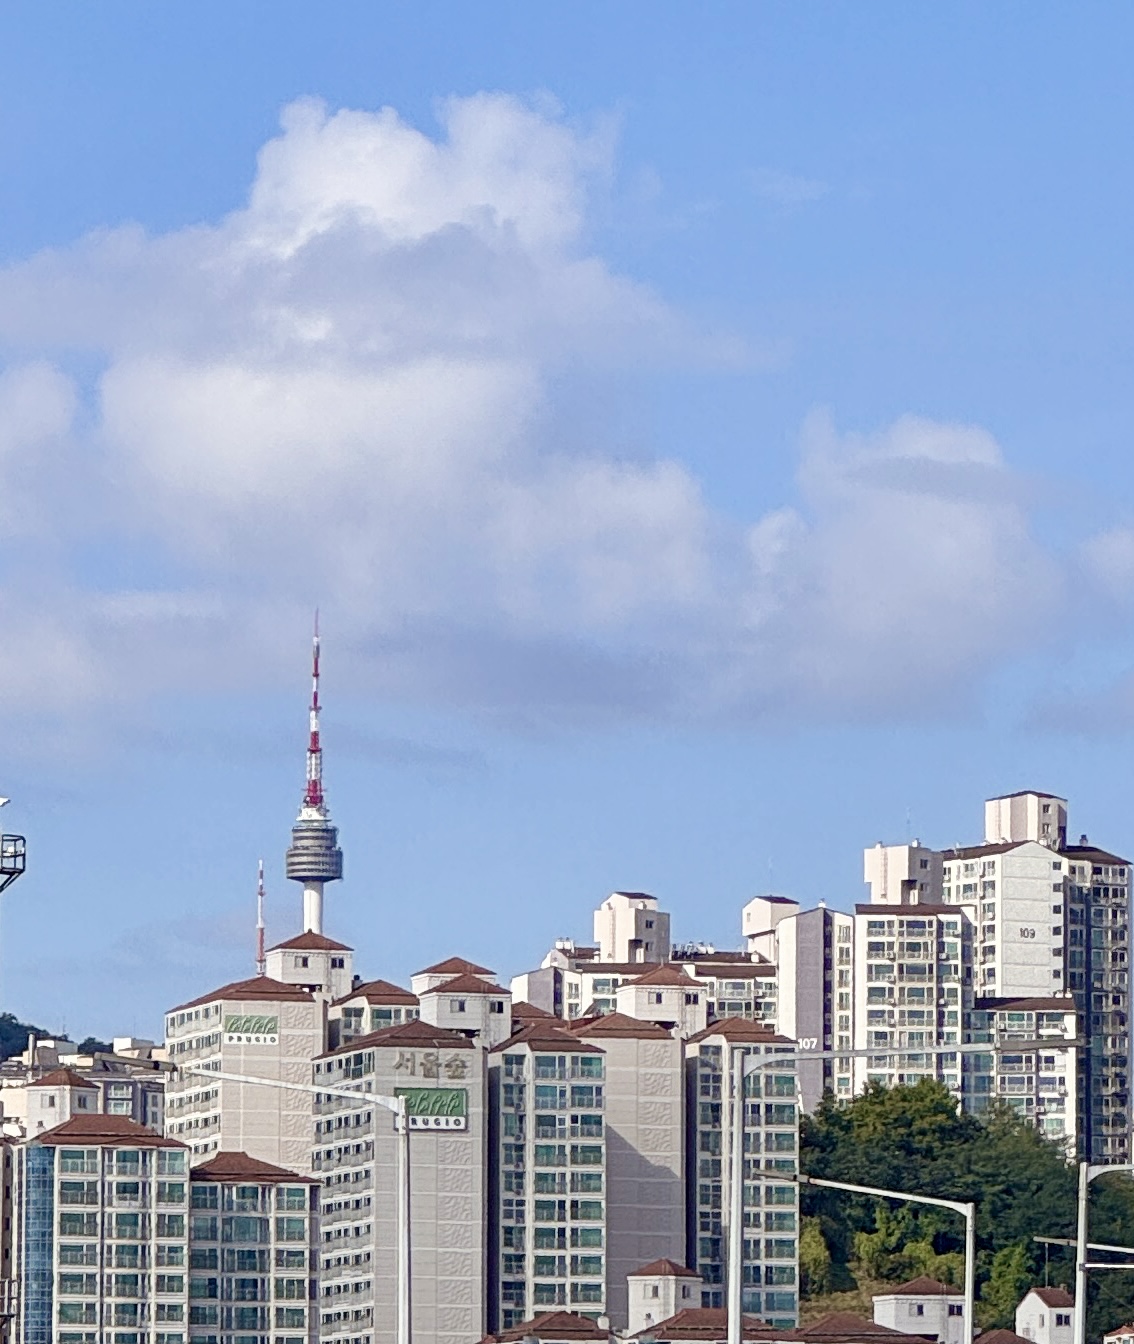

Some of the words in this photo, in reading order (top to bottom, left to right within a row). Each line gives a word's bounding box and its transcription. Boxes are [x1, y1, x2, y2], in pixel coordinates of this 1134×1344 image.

[228, 1035, 277, 1043] PRUGIO
[797, 1037, 818, 1050] 107
[410, 1117, 462, 1126] RUGIO
